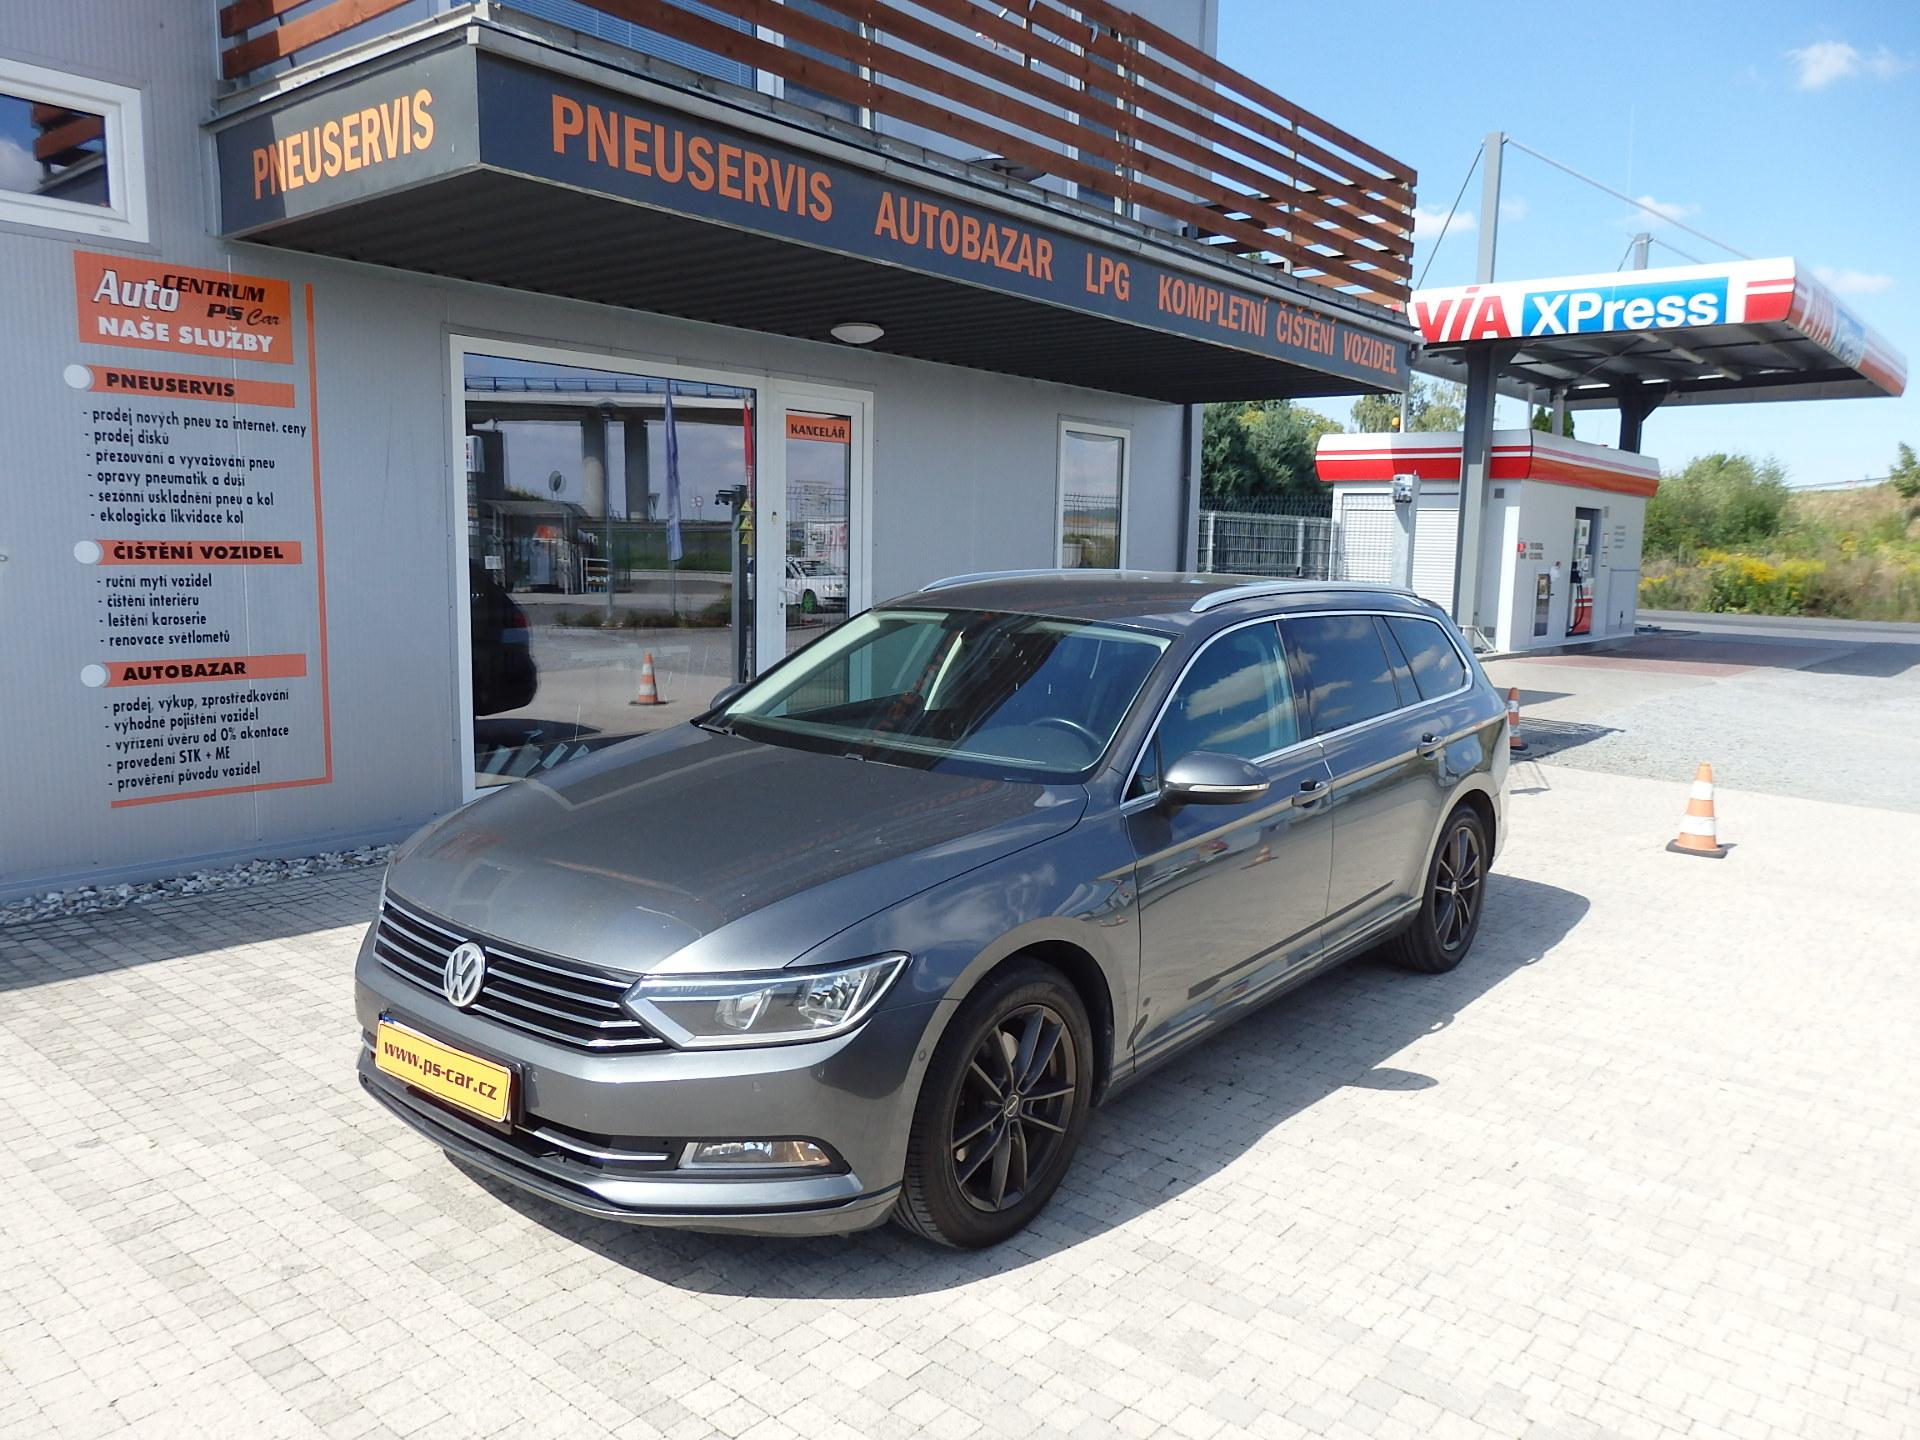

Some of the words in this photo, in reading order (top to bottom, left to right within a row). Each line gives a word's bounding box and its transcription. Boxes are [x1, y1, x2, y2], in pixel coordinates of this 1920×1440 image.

[252, 89, 434, 200] PNEUSERVIS
[552, 94, 833, 222] PNEUSERVIS
[874, 191, 1054, 281] AUTOBAZAR
[1085, 252, 1131, 301] LPG
[1158, 274, 1270, 337] KOMPLETNÍ
[1276, 301, 1337, 356] ČIŠTĚNÍ
[1344, 330, 1397, 374] VOZIDEL
[92, 268, 180, 312] Auto
[163, 274, 265, 303] CENTRUM
[207, 303, 244, 321] PS
[246, 309, 282, 326] Car
[1529, 292, 1719, 336] XPress
[97, 315, 170, 342] NAŠE
[179, 325, 273, 353] SLUŽBY
[106, 372, 235, 397] PNEUSERVIS
[92, 407, 132, 426] prodej
[184, 417, 212, 430] pneu
[216, 418, 229, 429] za
[232, 415, 279, 433] internet.
[282, 424, 307, 438] ceny
[791, 423, 846, 438] KANCELÁŘ
[94, 428, 134, 447] prodej
[96, 449, 164, 465] přezouvání
[168, 455, 176, 465] a
[180, 454, 246, 469] vyvažování
[249, 459, 275, 471] pneu
[97, 472, 140, 487] opravy
[146, 471, 208, 487] pneumatik
[212, 476, 219, 486] a
[148, 489, 212, 505] uskladnění
[216, 495, 242, 508] pneu
[246, 496, 254, 505] a
[257, 492, 274, 506] kol
[100, 507, 166, 526] ekologická
[171, 508, 223, 524] likvidace
[226, 510, 244, 524] kol
[113, 541, 193, 559] ČIŠTĚNÍ
[200, 546, 284, 559] VOZIDEL
[106, 574, 136, 588] ruční
[171, 573, 212, 588] vozidel
[107, 593, 146, 608] čištění
[149, 592, 199, 607] interiéru
[108, 612, 148, 627] leštění
[152, 611, 207, 626] karoserie
[109, 635, 164, 647] renovace
[168, 629, 230, 645] světlometů
[123, 661, 246, 681] AUTOBAZAR
[202, 687, 289, 709] zprostředkování
[220, 707, 259, 723] vozidel
[203, 729, 217, 743] od
[221, 726, 237, 741] 0%
[240, 726, 289, 740] akontace
[116, 752, 176, 774] provedení
[179, 748, 202, 764] STK
[215, 745, 230, 760] ME
[178, 764, 219, 786] původu
[222, 760, 261, 777] vozidel
[383, 1040, 498, 1100] www.ps-car.cz
